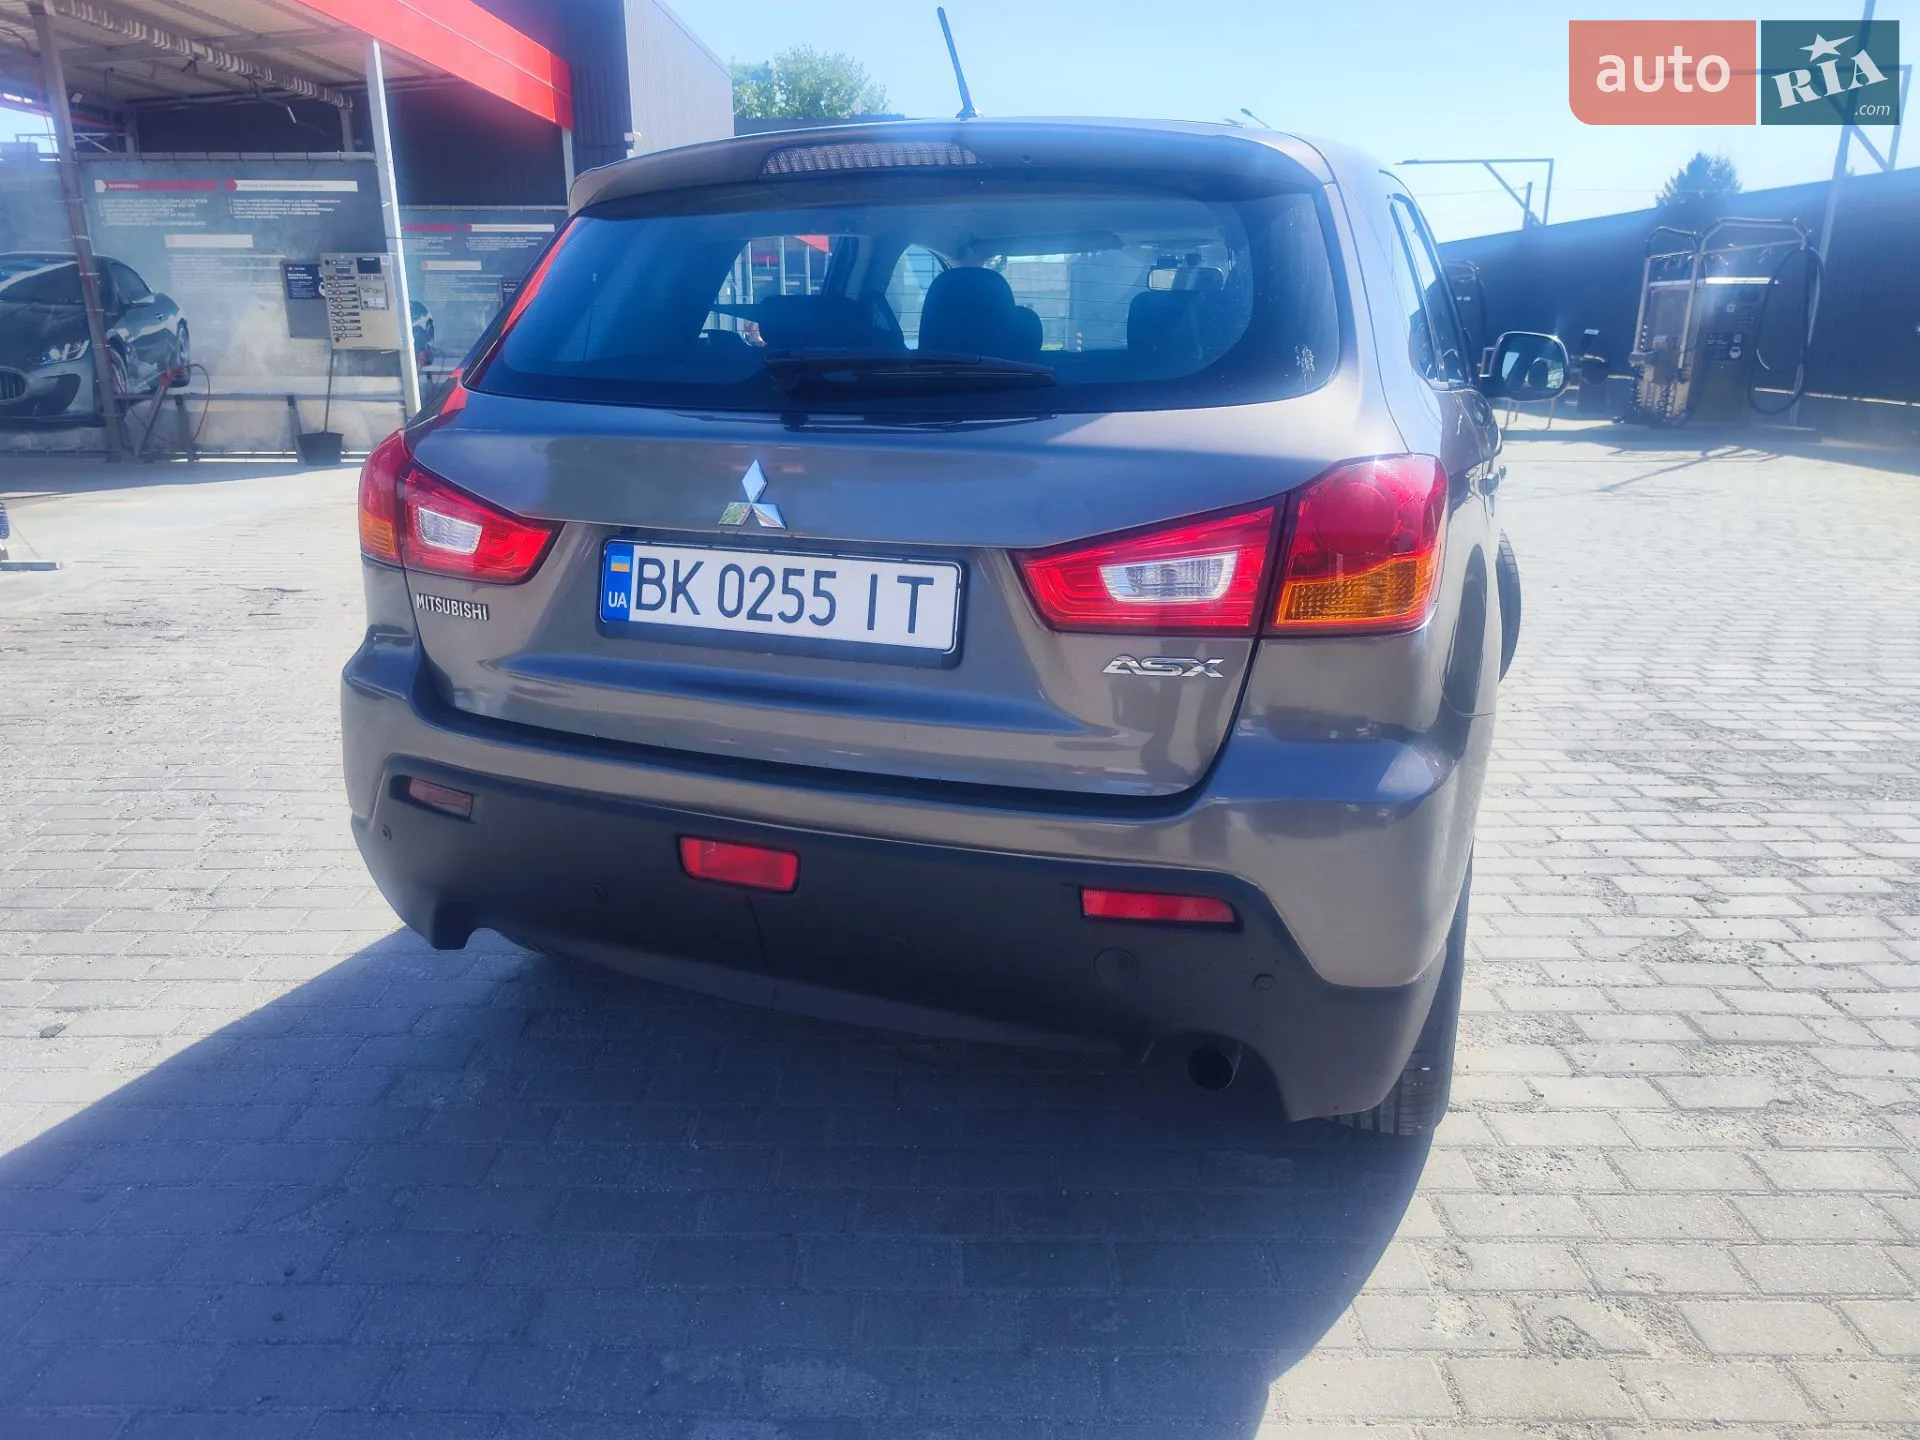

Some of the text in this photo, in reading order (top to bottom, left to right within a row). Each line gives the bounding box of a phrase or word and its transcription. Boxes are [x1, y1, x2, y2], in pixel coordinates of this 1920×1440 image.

[416, 593, 489, 621] MITSUBISHI
[608, 591, 628, 609] UA
[634, 557, 935, 634] BK 0255 IT
[1102, 654, 1225, 678] ASX
